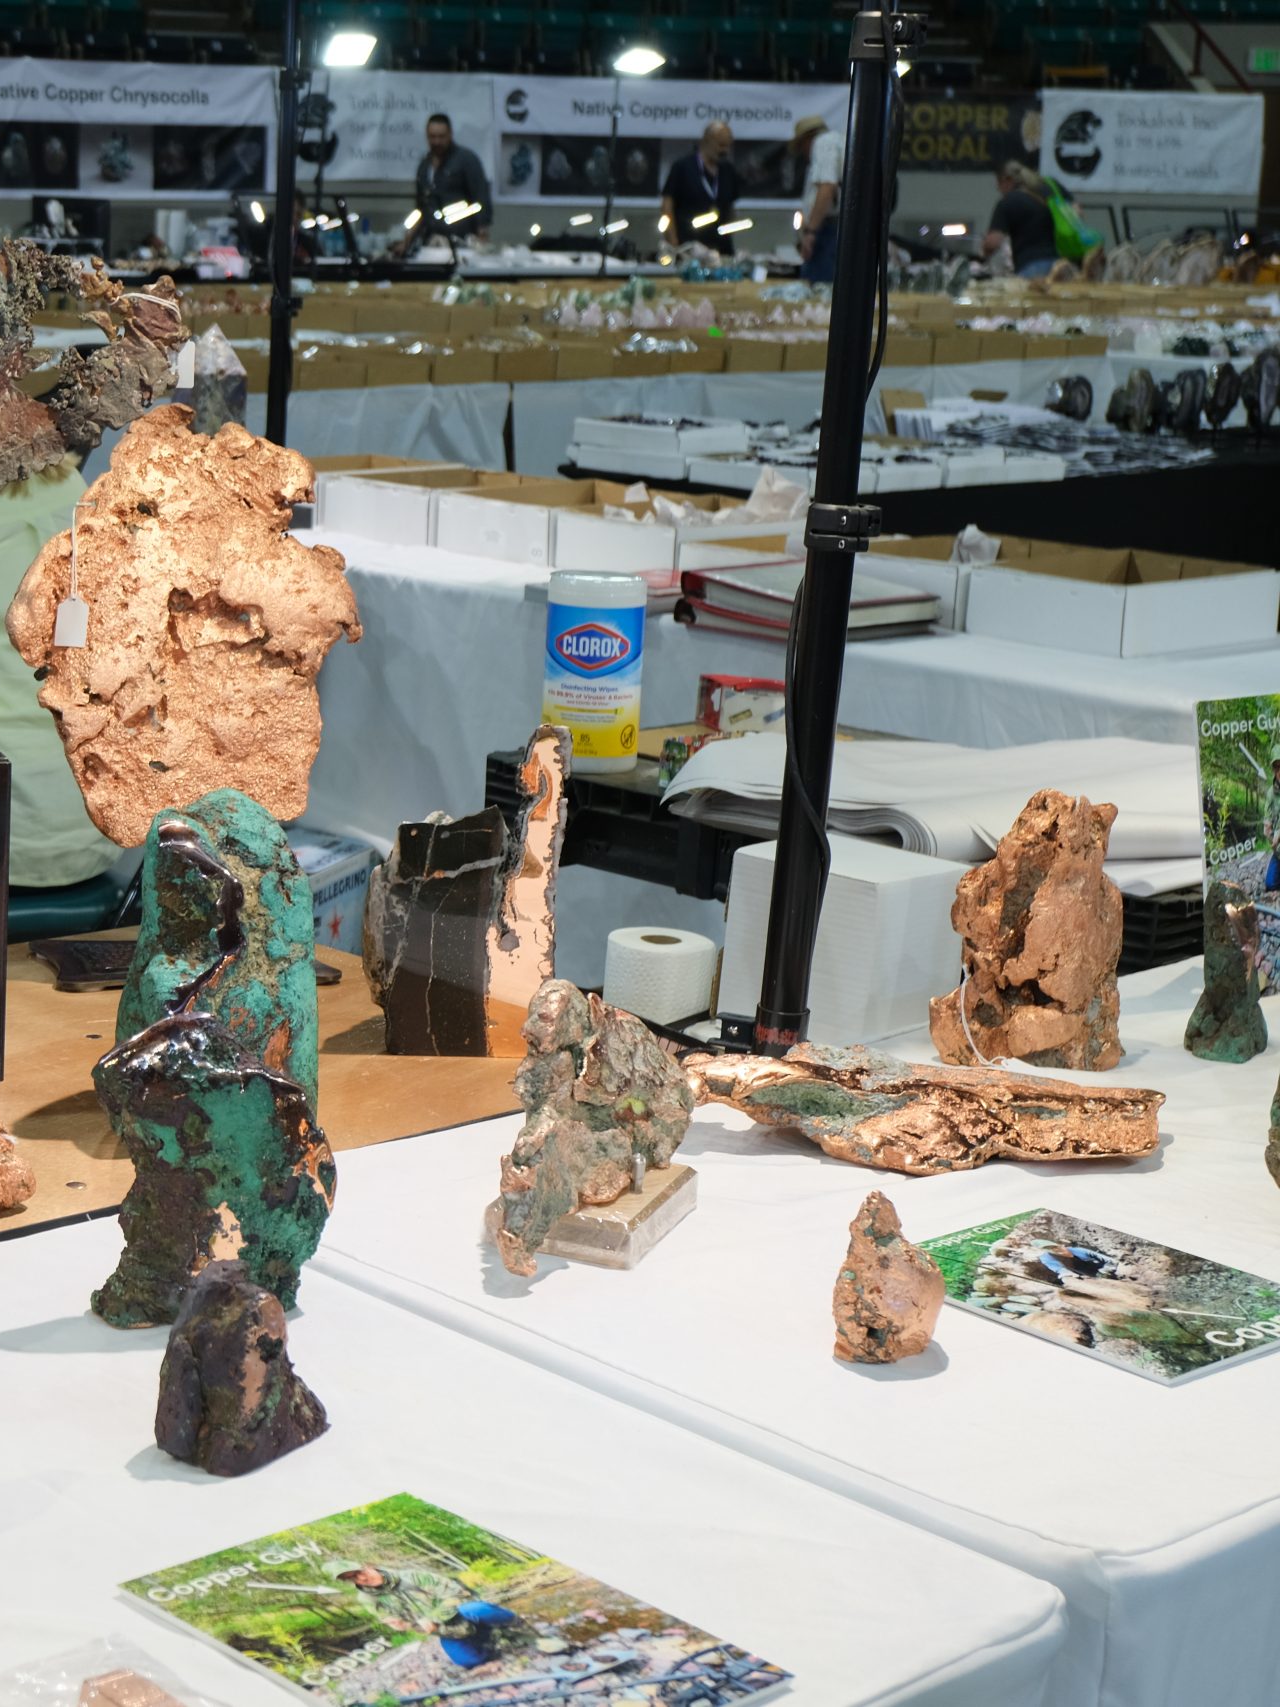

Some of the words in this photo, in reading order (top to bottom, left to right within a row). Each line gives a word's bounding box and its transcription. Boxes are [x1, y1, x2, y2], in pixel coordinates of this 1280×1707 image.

[44, 83, 105, 105] Copper
[110, 85, 210, 108] Chrysocolla
[630, 101, 690, 121] Copper
[695, 102, 793, 122] Chrysocolla
[563, 634, 622, 658] CLOROX
[1201, 719, 1254, 740] Copper
[1209, 836, 1257, 866] Copper
[313, 869, 367, 906] PELLEGRINO
[972, 1223, 1010, 1234] Guy
[147, 1559, 260, 1602] Copper
[260, 1540, 323, 1566] Guy
[300, 1635, 393, 1687] Copper
